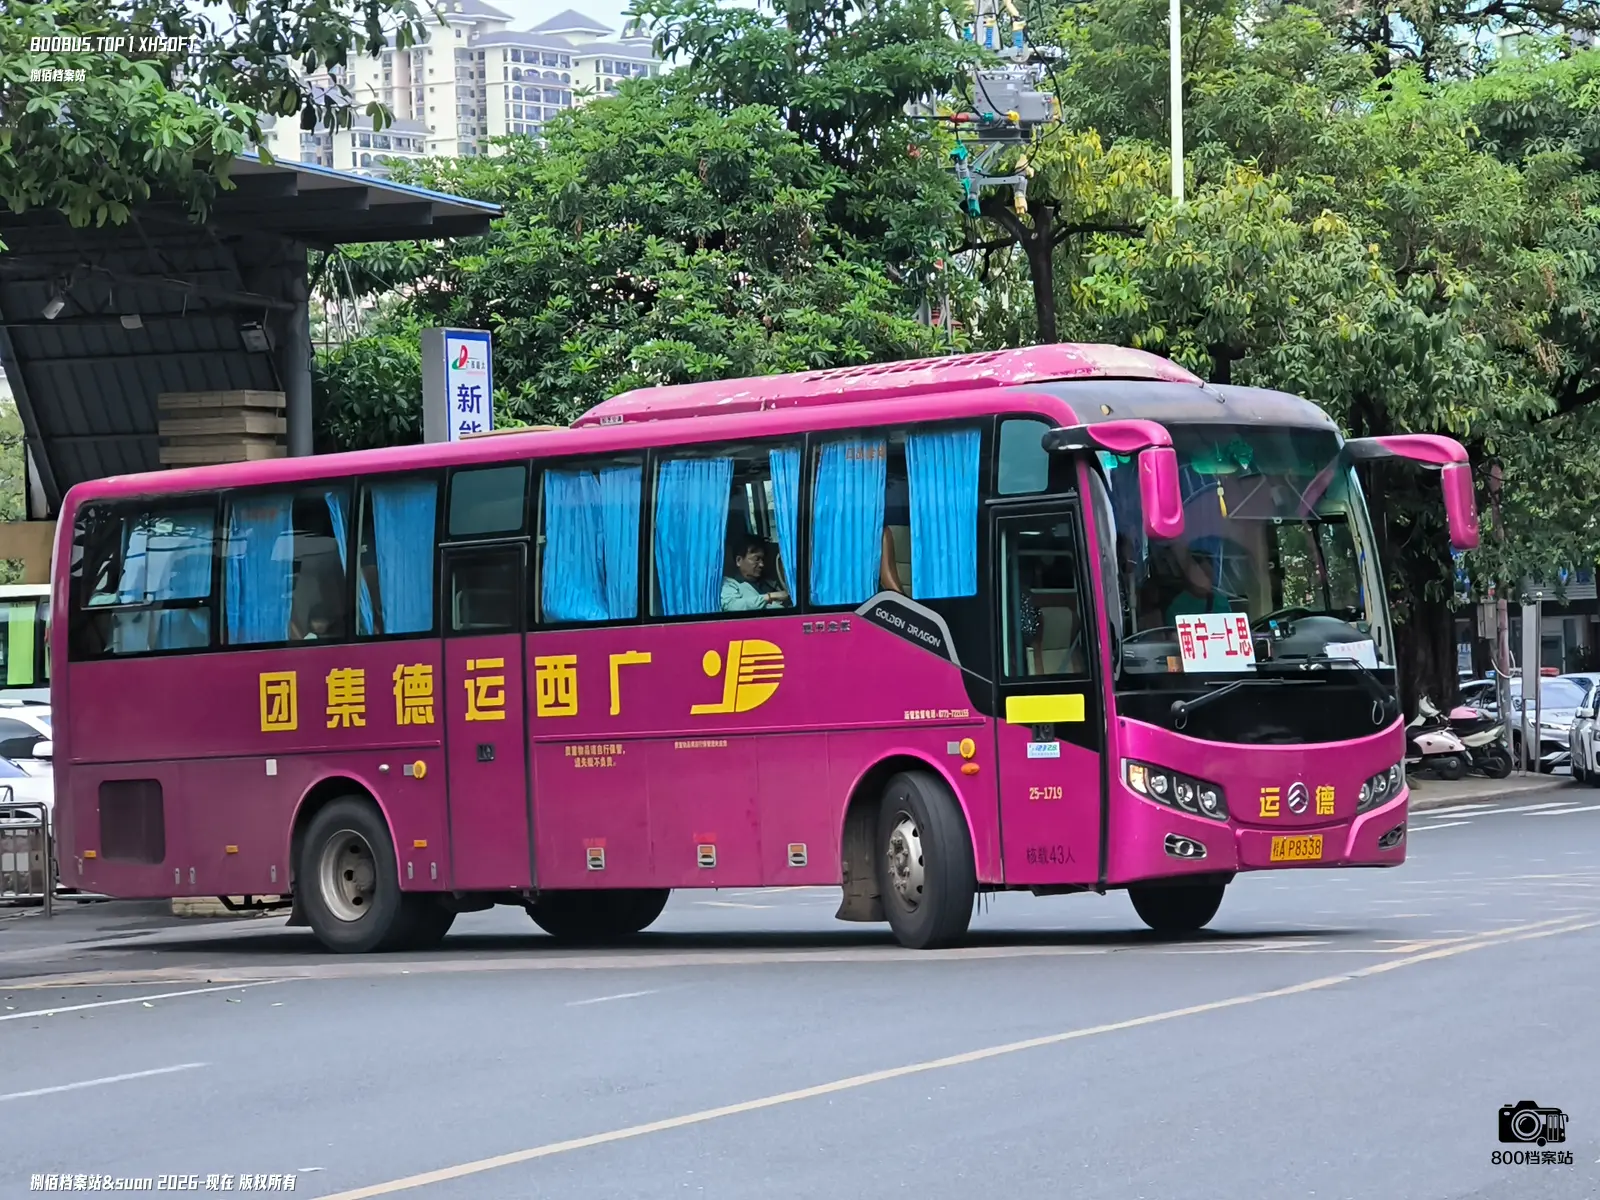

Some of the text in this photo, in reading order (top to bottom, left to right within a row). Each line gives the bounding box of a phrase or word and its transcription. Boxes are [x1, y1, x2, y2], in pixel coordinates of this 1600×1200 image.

[875, 607, 941, 648] GOLDEN DRAGON
[1178, 617, 1253, 660] 南宁 上思
[1029, 786, 1063, 800] 25-1719
[1259, 785, 1335, 817] 运 德
[1026, 845, 1076, 865] 核载43人
